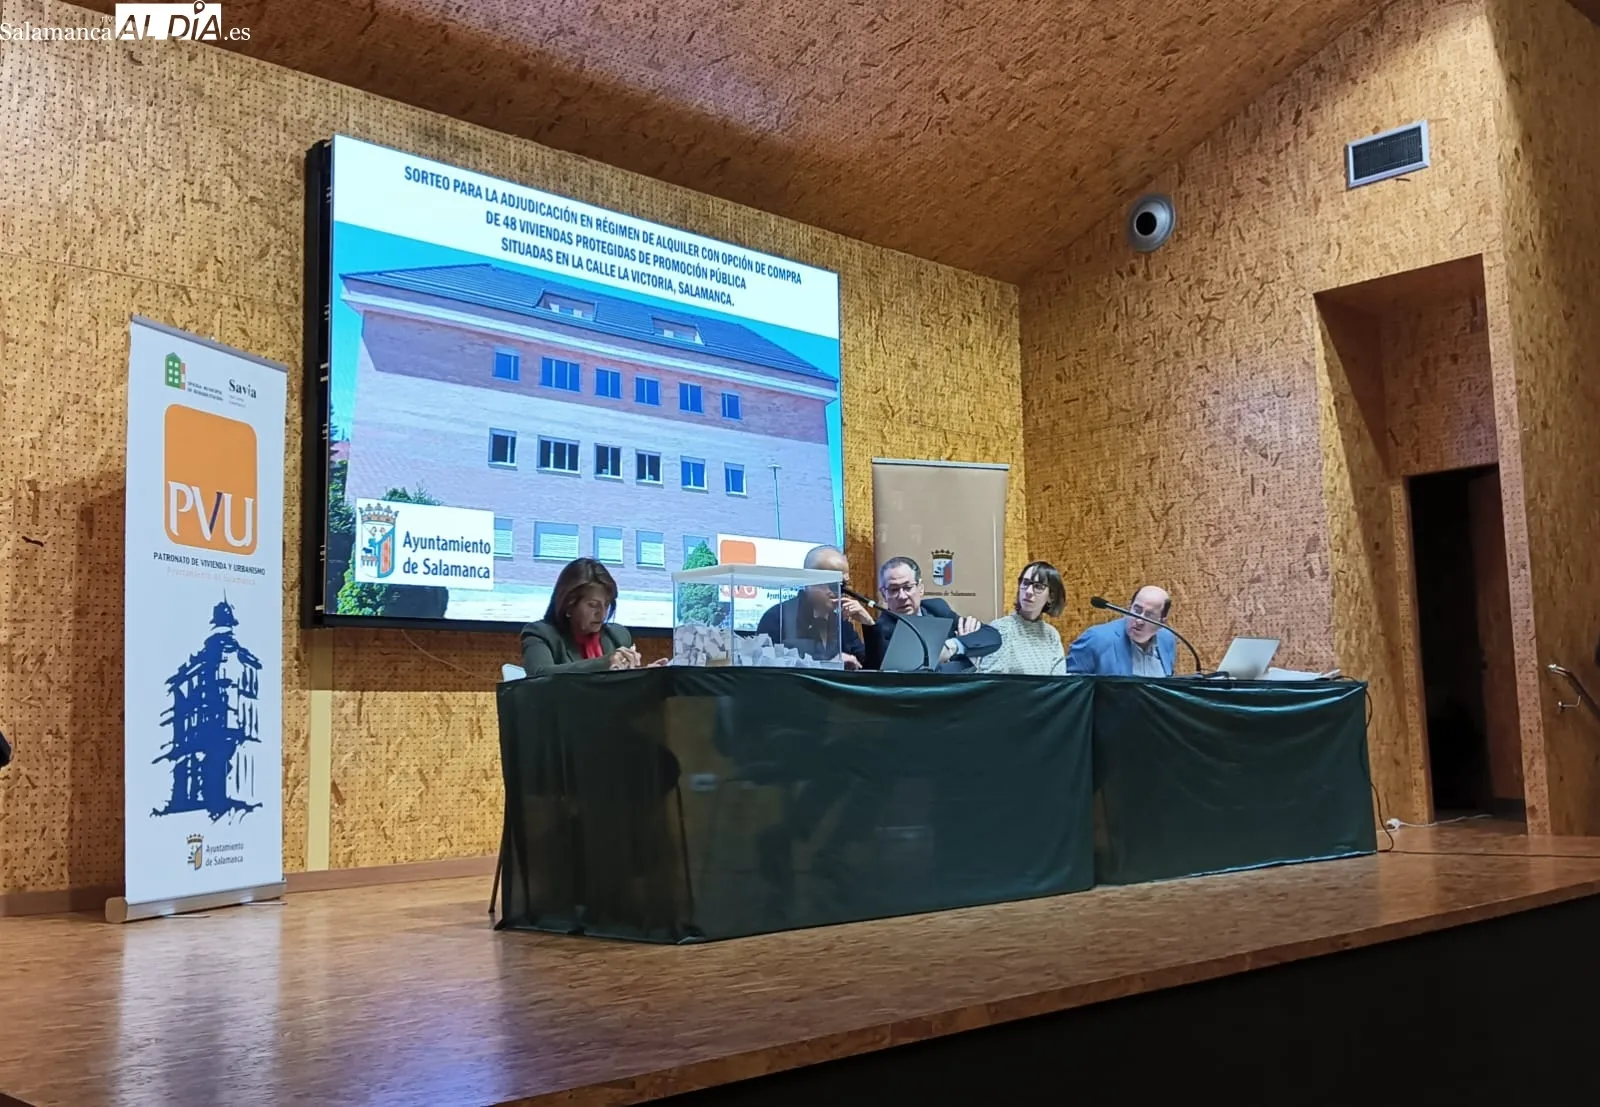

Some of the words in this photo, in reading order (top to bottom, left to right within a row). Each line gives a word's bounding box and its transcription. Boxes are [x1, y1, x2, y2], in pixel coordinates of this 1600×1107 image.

[404, 165, 450, 191] SORTEO
[453, 178, 483, 200] PARA
[485, 187, 499, 204] LA
[500, 192, 578, 225] ADJUDICACIÓN
[580, 213, 593, 229] EN
[596, 216, 640, 240] RÉGIMEN
[642, 230, 654, 246] DE
[656, 235, 699, 258] ALQUILER
[701, 247, 720, 262] CON
[721, 253, 753, 273] OPCIÓN
[755, 263, 766, 276] DE
[767, 265, 802, 285] COMPRA
[486, 210, 501, 227] DE
[502, 215, 517, 231] 48
[519, 219, 573, 246] VIVIENDAS
[575, 234, 636, 262] PROTEGIDAS
[639, 252, 651, 266] DE
[652, 256, 708, 280] PROMOCIÓN
[709, 268, 747, 290] PÚBLICA
[501, 237, 553, 263] SITUADAS
[555, 251, 569, 268] EN
[571, 255, 584, 271] LA
[585, 259, 616, 278] CALLE
[618, 266, 630, 281] LA
[631, 269, 676, 295] VICTORIA,
[678, 281, 735, 307] SALAMANCA.
[168, 481, 254, 547] PVU
[403, 531, 491, 553] Ayuntamiento
[153, 551, 190, 566] PATRONATO
[191, 558, 199, 566] DE
[200, 559, 227, 570] VIVIENDA
[233, 564, 266, 576] URBANISMO
[403, 557, 418, 574] de
[423, 558, 490, 579] Salamanca
[206, 843, 244, 853] Ayuntamiento
[206, 857, 212, 866] de
[214, 856, 243, 865] Salamanca
